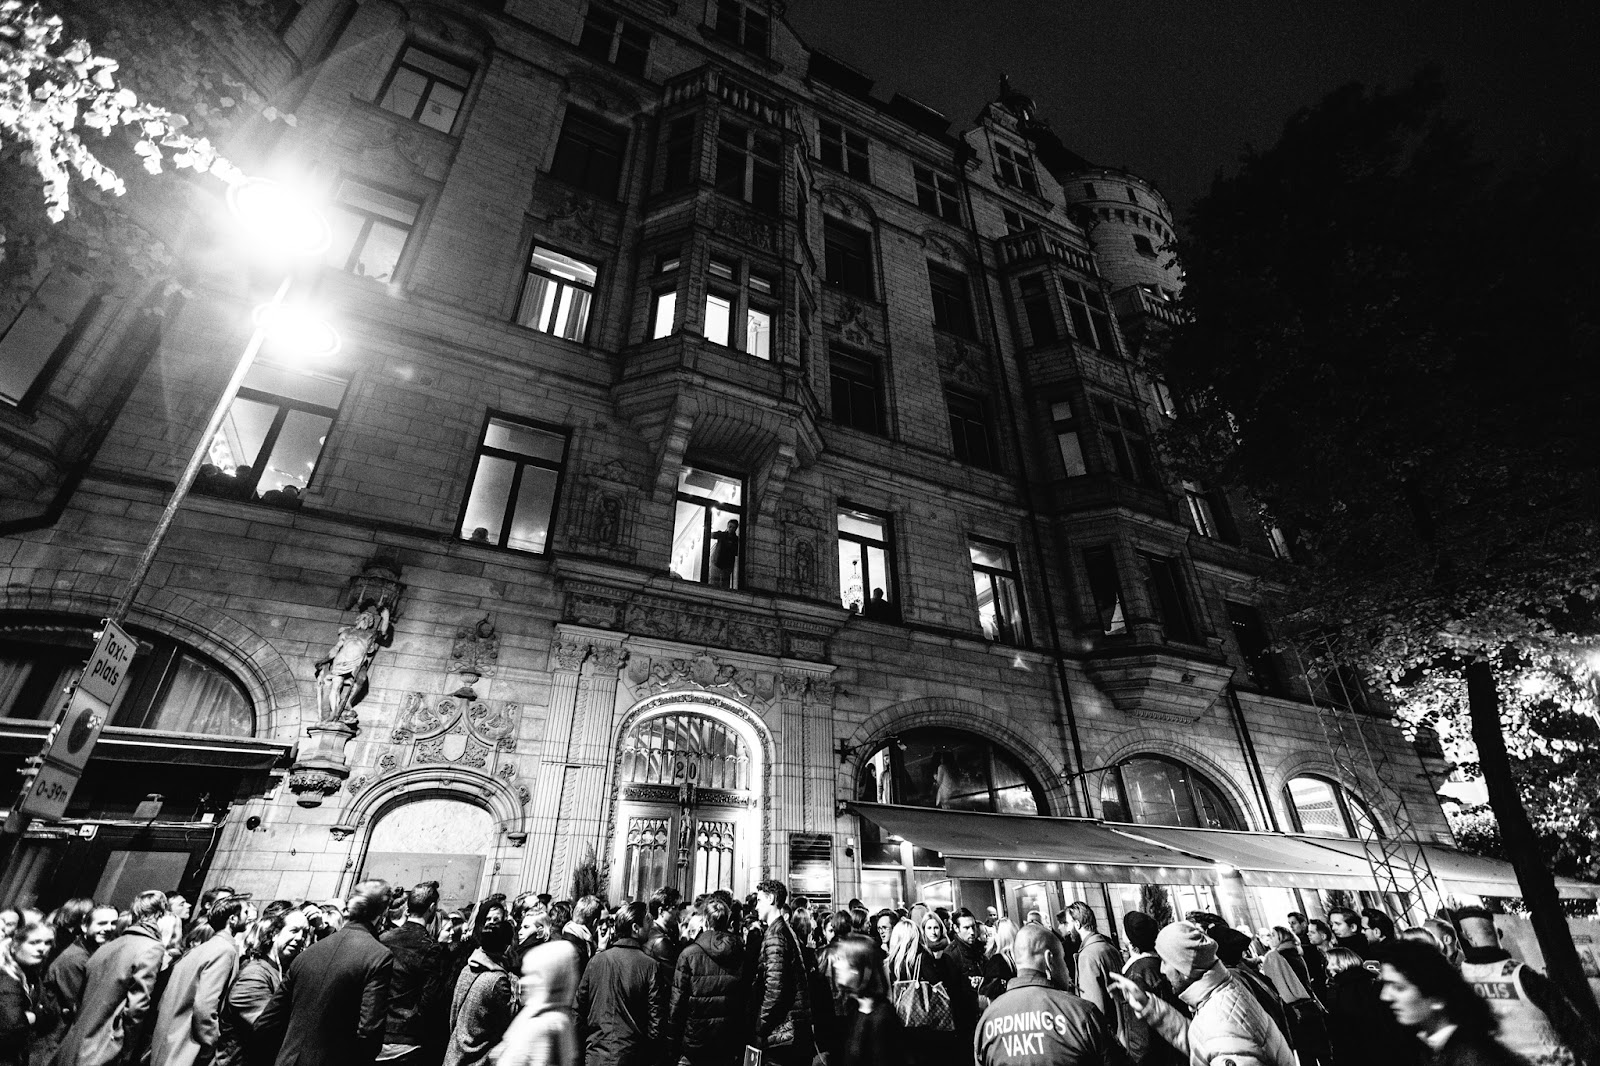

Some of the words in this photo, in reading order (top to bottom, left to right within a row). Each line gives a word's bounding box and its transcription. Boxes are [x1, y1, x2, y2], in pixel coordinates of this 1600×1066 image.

[105, 632, 127, 662] Taxi-
[91, 659, 119, 685] plats
[676, 761, 697, 780] 20
[36, 780, 67, 803] 0-39m
[1473, 982, 1510, 999] OLIS
[985, 1010, 1067, 1040] ORDNINGS
[1002, 1032, 1045, 1057] VAKT
